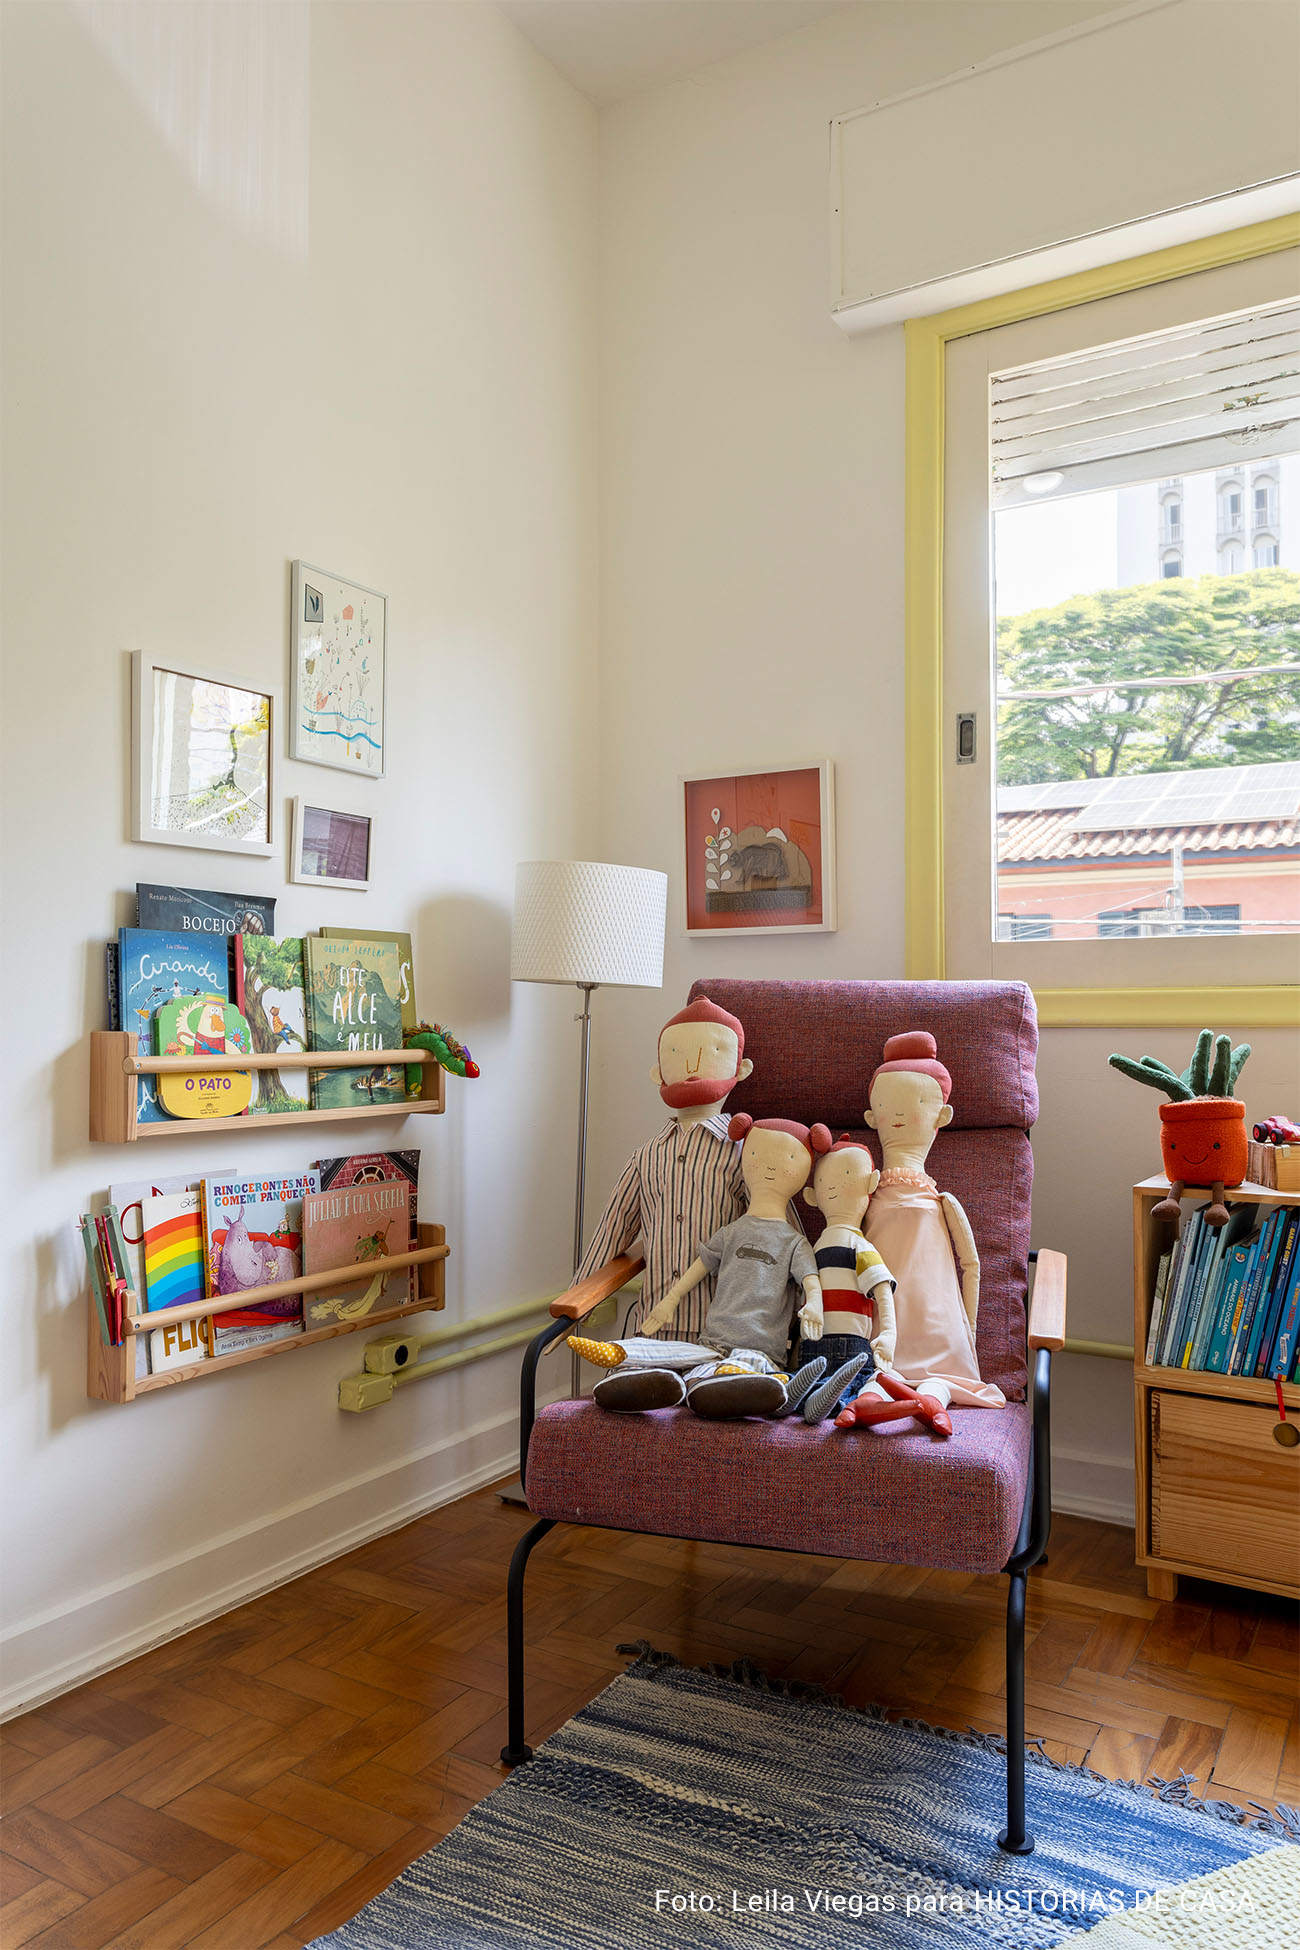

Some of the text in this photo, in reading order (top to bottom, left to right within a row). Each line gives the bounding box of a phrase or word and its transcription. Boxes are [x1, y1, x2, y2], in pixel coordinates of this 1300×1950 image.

[182, 915, 236, 935] BOCEJO
[138, 954, 224, 990] Ciranda
[340, 966, 366, 987] ESTE
[333, 991, 377, 1025] ALCE
[337, 1027, 345, 1042] é
[185, 1077, 232, 1091] O PATO
[213, 1175, 315, 1196] RINOCERONTES NÃO
[214, 1194, 257, 1207] COMEM
[260, 1188, 316, 1202] PANQUECAS
[308, 1194, 342, 1228] JULIÁN
[345, 1191, 350, 1217] É
[374, 1187, 405, 1211] SEREIA
